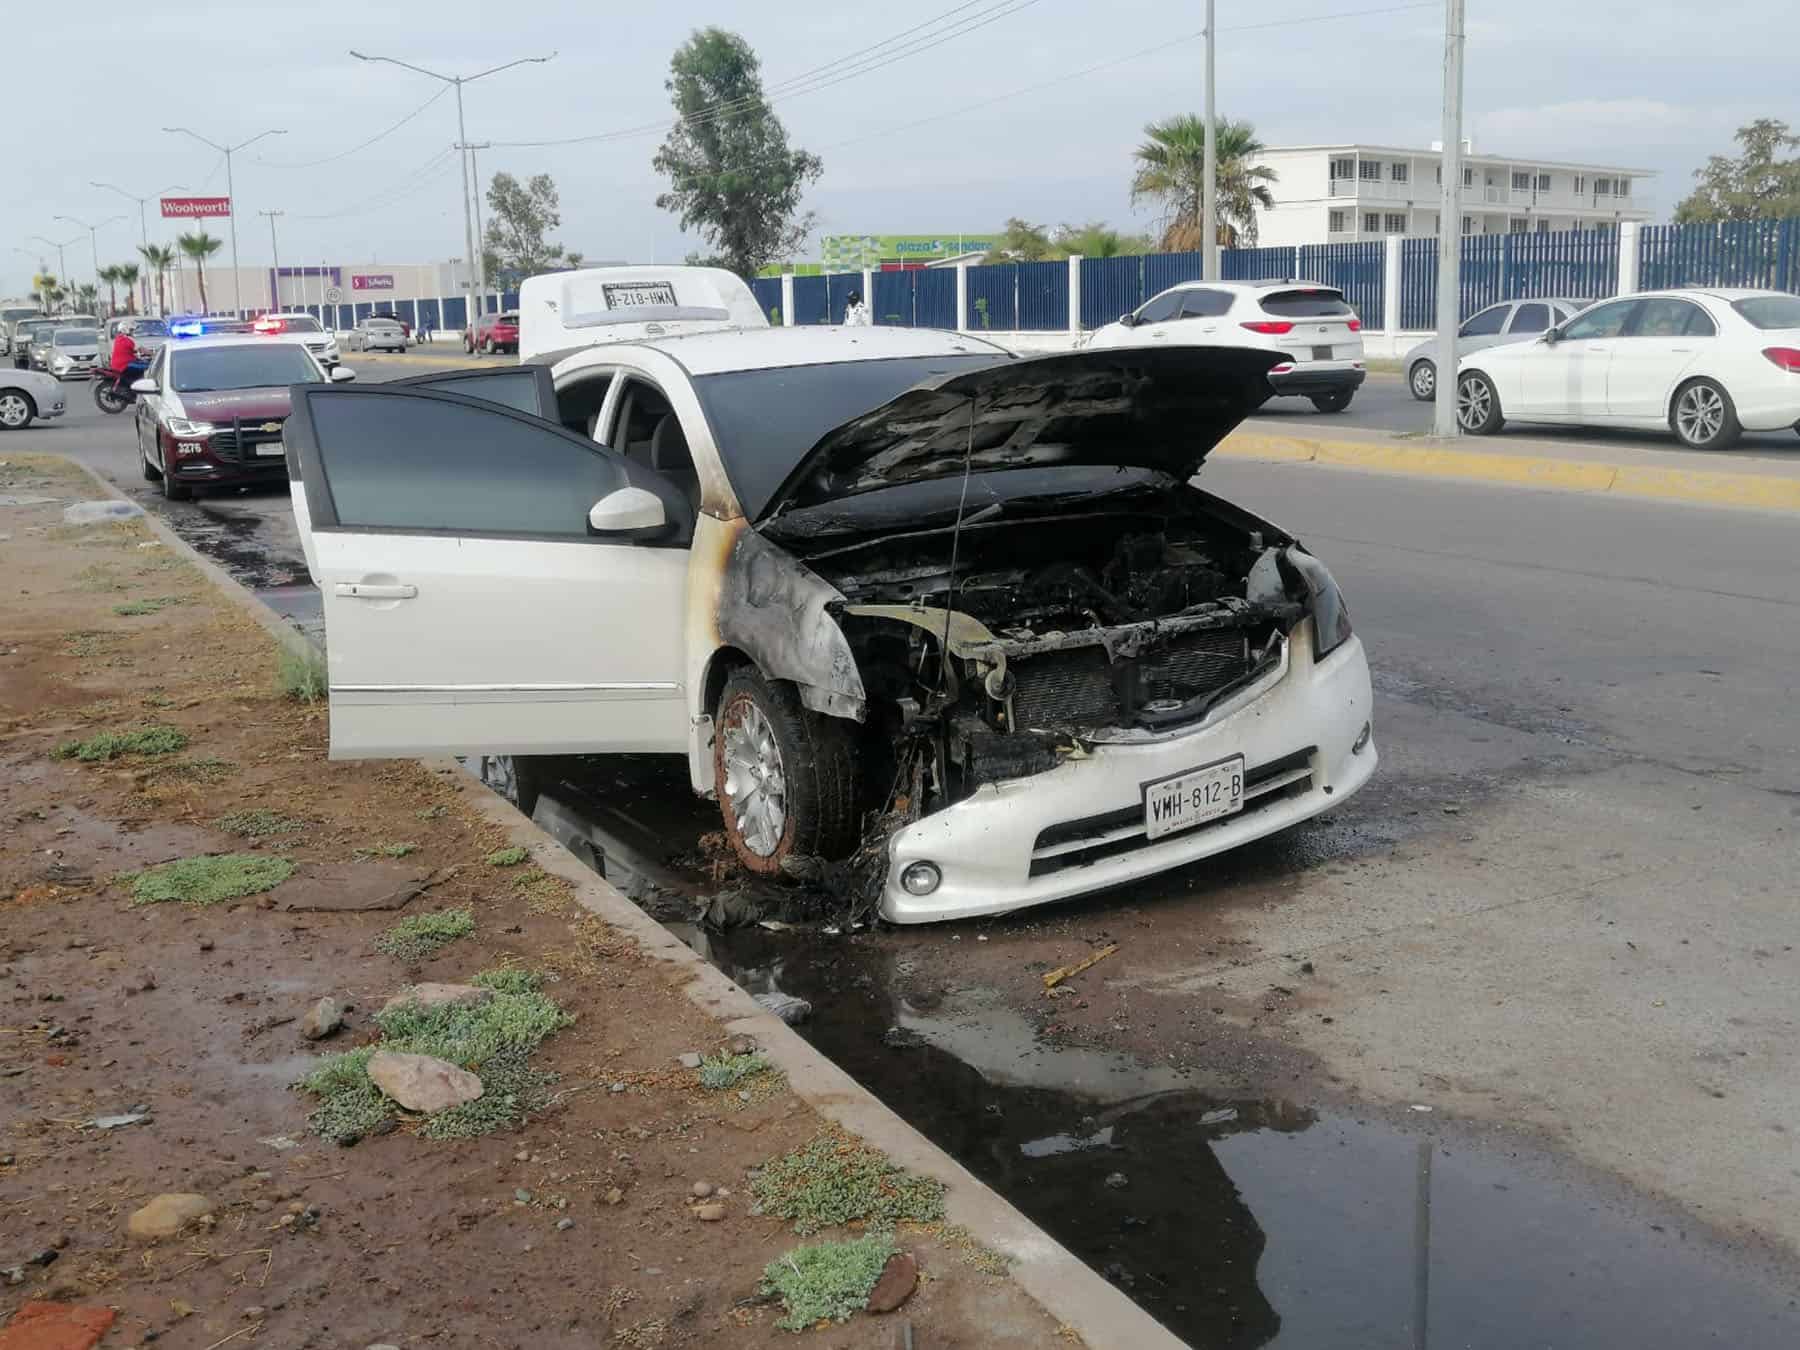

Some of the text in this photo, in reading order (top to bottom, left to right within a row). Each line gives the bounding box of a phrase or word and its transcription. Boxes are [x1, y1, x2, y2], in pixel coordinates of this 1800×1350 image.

[163, 200, 231, 214] Woolworth
[896, 240, 930, 254] plaza
[1152, 774, 1241, 822] VMH-812-B
